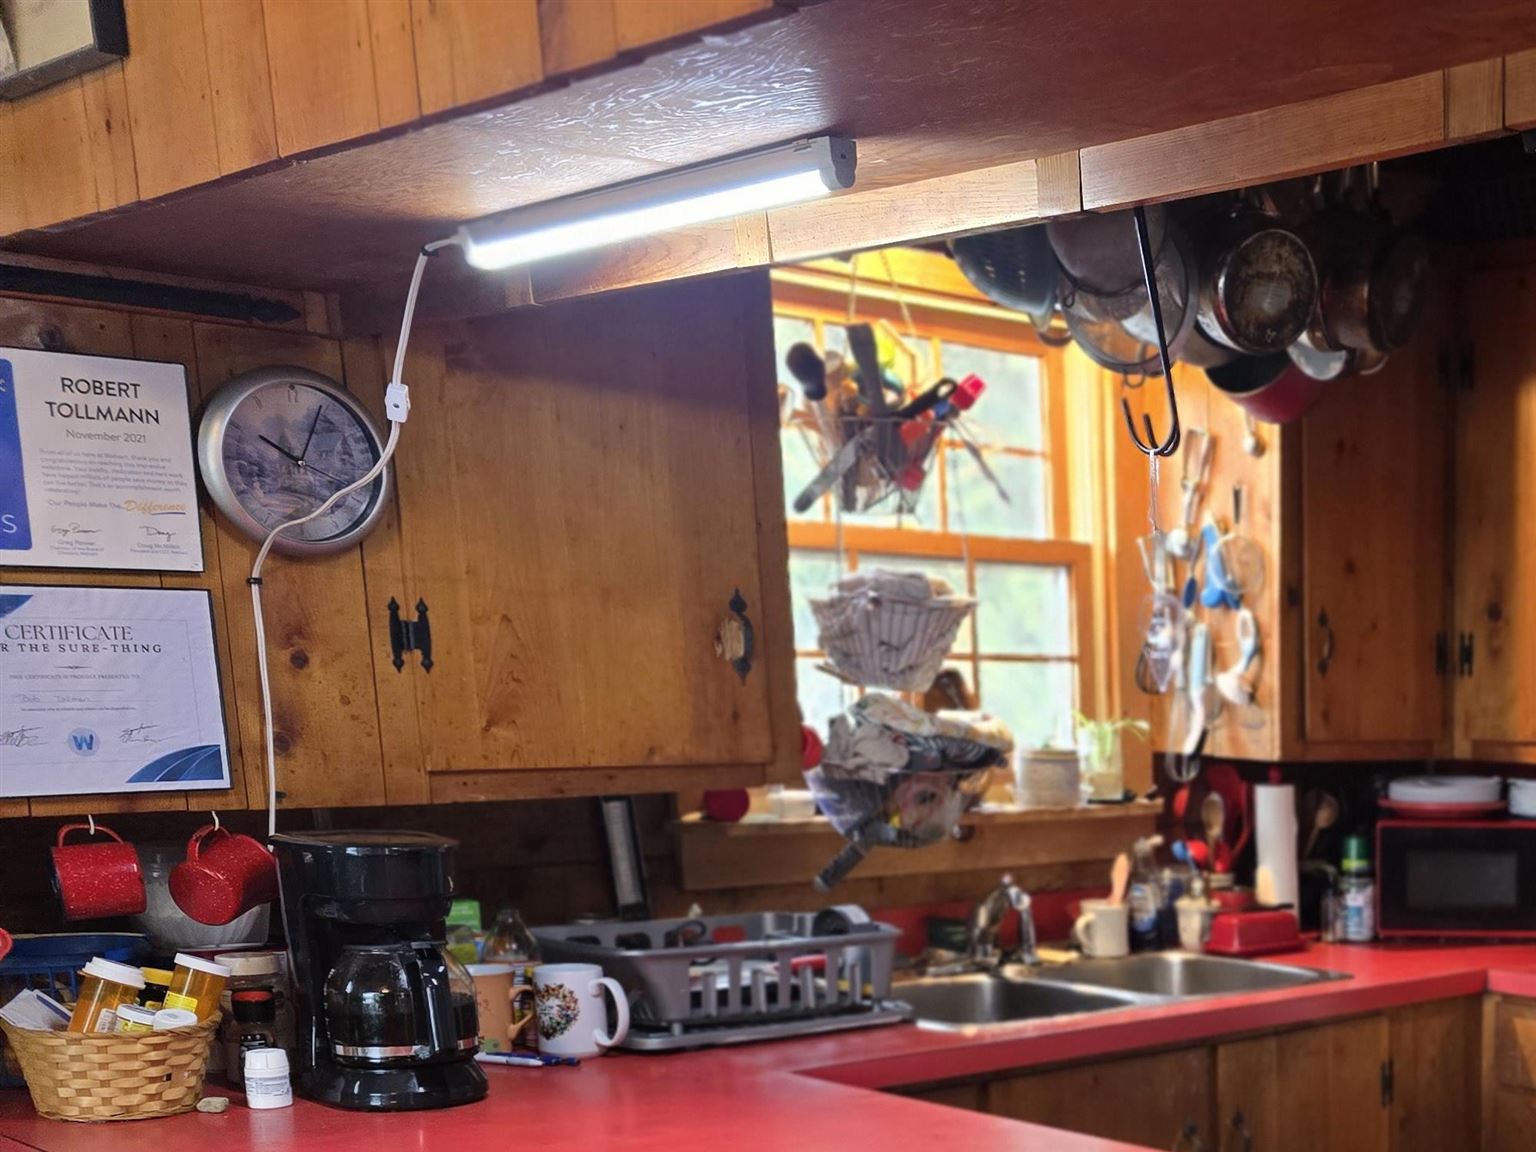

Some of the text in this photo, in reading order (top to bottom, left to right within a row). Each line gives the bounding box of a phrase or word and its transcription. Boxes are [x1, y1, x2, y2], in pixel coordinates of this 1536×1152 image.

[60, 377, 141, 399] ROBERT
[45, 401, 160, 425] TOLLMANN
[66, 429, 147, 444] November 2021
[123, 499, 187, 515] Difference
[4, 624, 133, 641] CERTIFICATE
[18, 642, 50, 653] THE
[58, 642, 162, 654] SURE-THING
